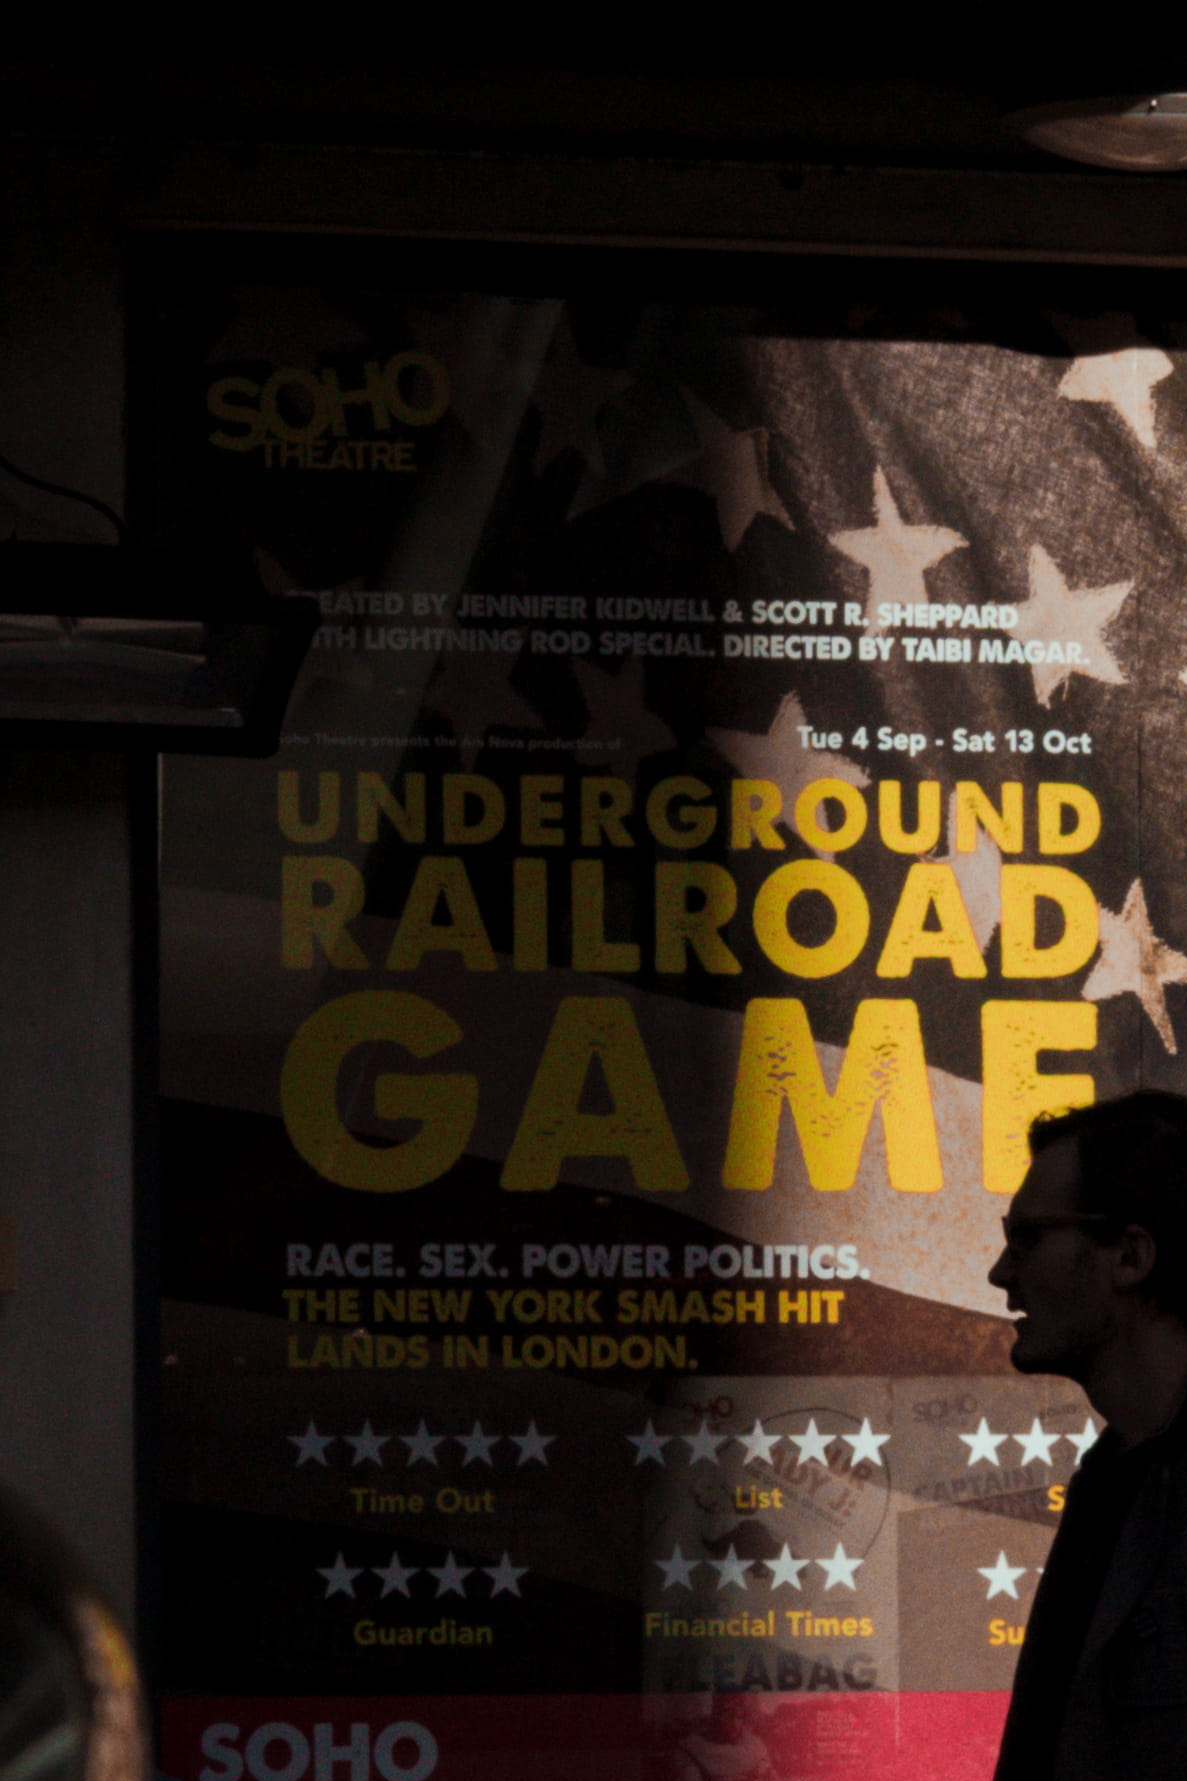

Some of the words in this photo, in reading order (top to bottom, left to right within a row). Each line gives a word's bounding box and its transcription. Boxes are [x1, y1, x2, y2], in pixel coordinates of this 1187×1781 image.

[207, 351, 451, 452] SOHO
[263, 441, 418, 472] THEATRE
[317, 591, 404, 617] EATED
[412, 592, 448, 617] BY
[456, 593, 590, 622] JENNIFER
[595, 595, 716, 625] KIDWELL
[722, 598, 744, 623] &
[752, 600, 839, 626] SCOTT
[844, 601, 870, 627] R.
[878, 602, 1018, 630] SHEPPARD
[311, 624, 357, 650] ITH
[364, 626, 524, 655] LIGHTNING
[530, 629, 592, 657] ROD
[599, 631, 716, 658] SPECIAL.
[724, 633, 852, 661] DIRECTED
[858, 636, 895, 662] BY
[901, 637, 971, 663] TAIBI
[978, 638, 1091, 665] MAGAR.
[797, 725, 844, 752] Tue
[851, 725, 870, 751] 4
[877, 726, 927, 757] Sep
[952, 728, 996, 754] Sat
[1005, 728, 1035, 755] 13
[1042, 729, 1092, 755] Oct
[277, 771, 1103, 855] UNDERGROUND
[280, 855, 1101, 980] RAILROAD
[286, 1242, 406, 1279] RACE.
[418, 1243, 510, 1279] SEX.
[521, 1243, 672, 1280] POWER
[683, 1243, 871, 1280] POLITICS.
[281, 1288, 363, 1324] THE
[372, 1288, 470, 1324] NEW
[488, 1288, 605, 1324] YORK
[616, 1288, 766, 1324] SMASH
[777, 1288, 845, 1325] HIT
[287, 1335, 430, 1369] LANDS
[442, 1335, 488, 1369] IN
[501, 1335, 699, 1370] LONDON.
[350, 1487, 426, 1515] Time
[436, 1487, 496, 1515] Out
[734, 1485, 784, 1511] List
[351, 1617, 496, 1648] Guardian
[644, 1611, 775, 1640] Financial
[785, 1610, 874, 1639] Times
